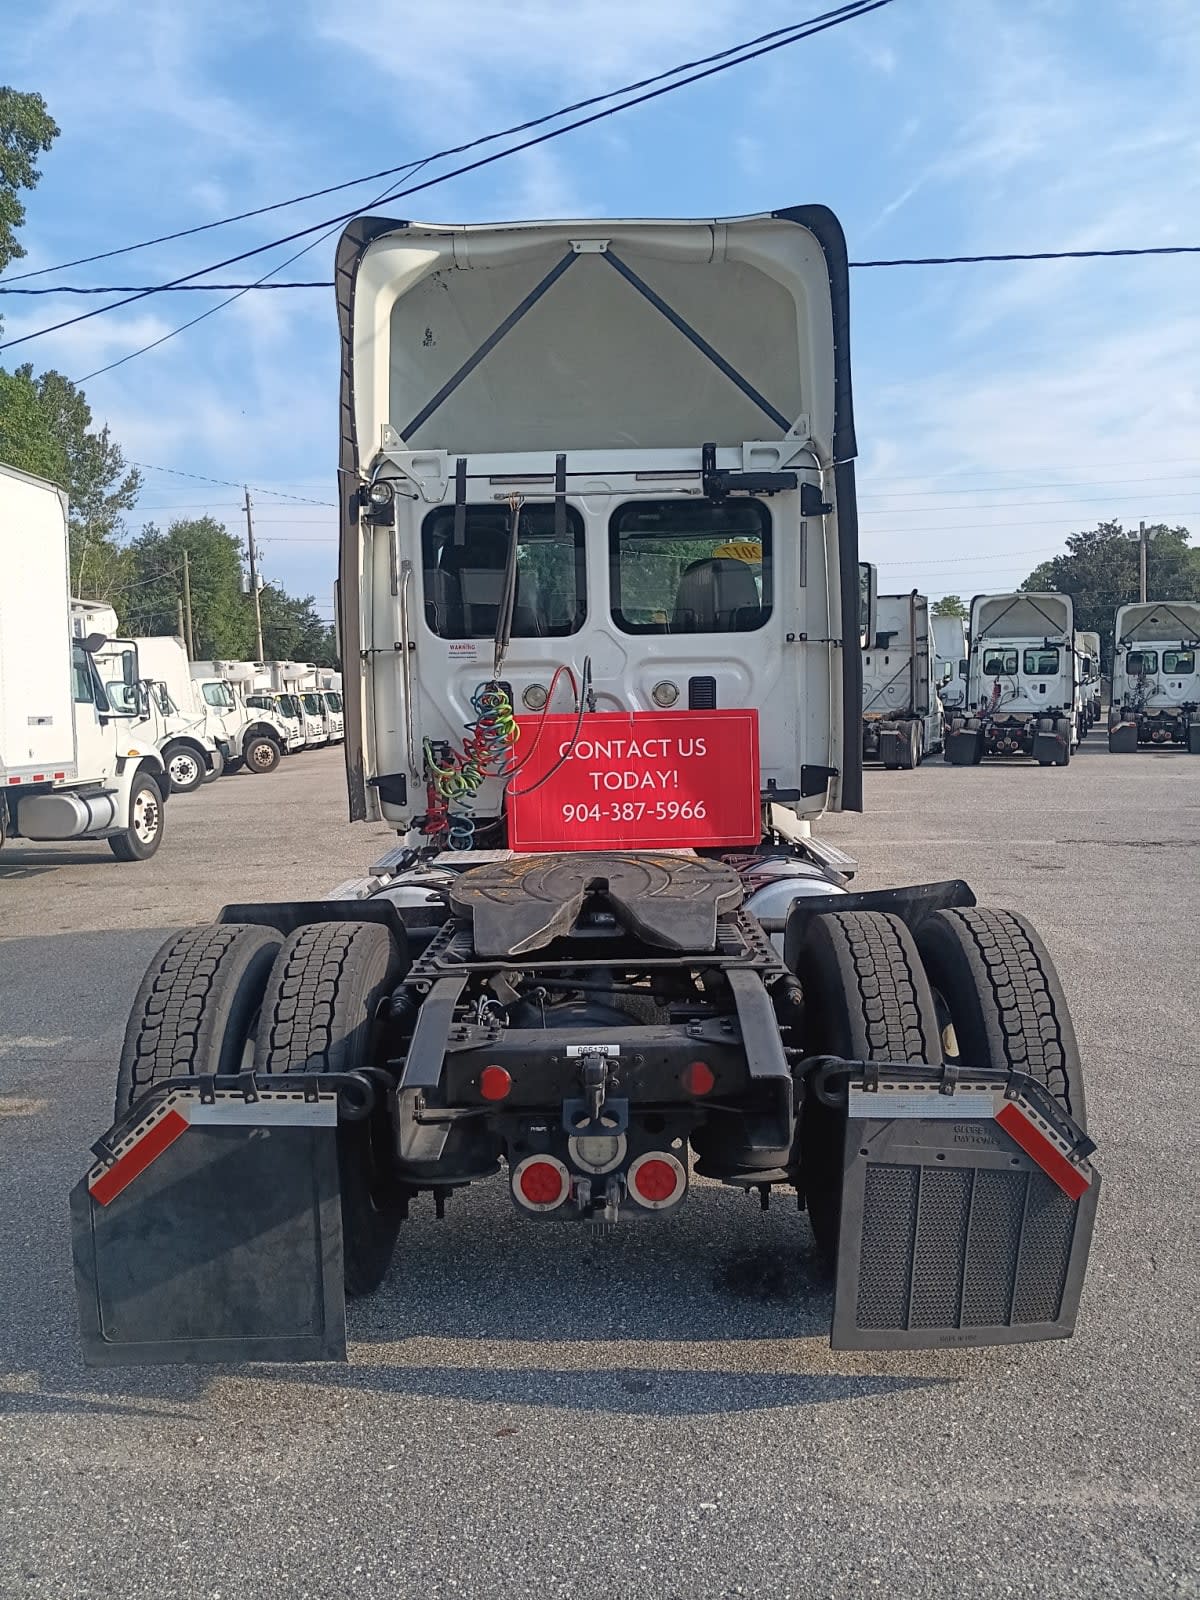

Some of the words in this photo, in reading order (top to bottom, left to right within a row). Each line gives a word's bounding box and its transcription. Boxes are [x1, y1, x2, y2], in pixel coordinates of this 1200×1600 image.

[558, 738, 672, 760] CONTACT
[678, 738, 707, 757] US
[589, 770, 679, 791] TODAY!
[562, 800, 707, 822] 904-387-5966
